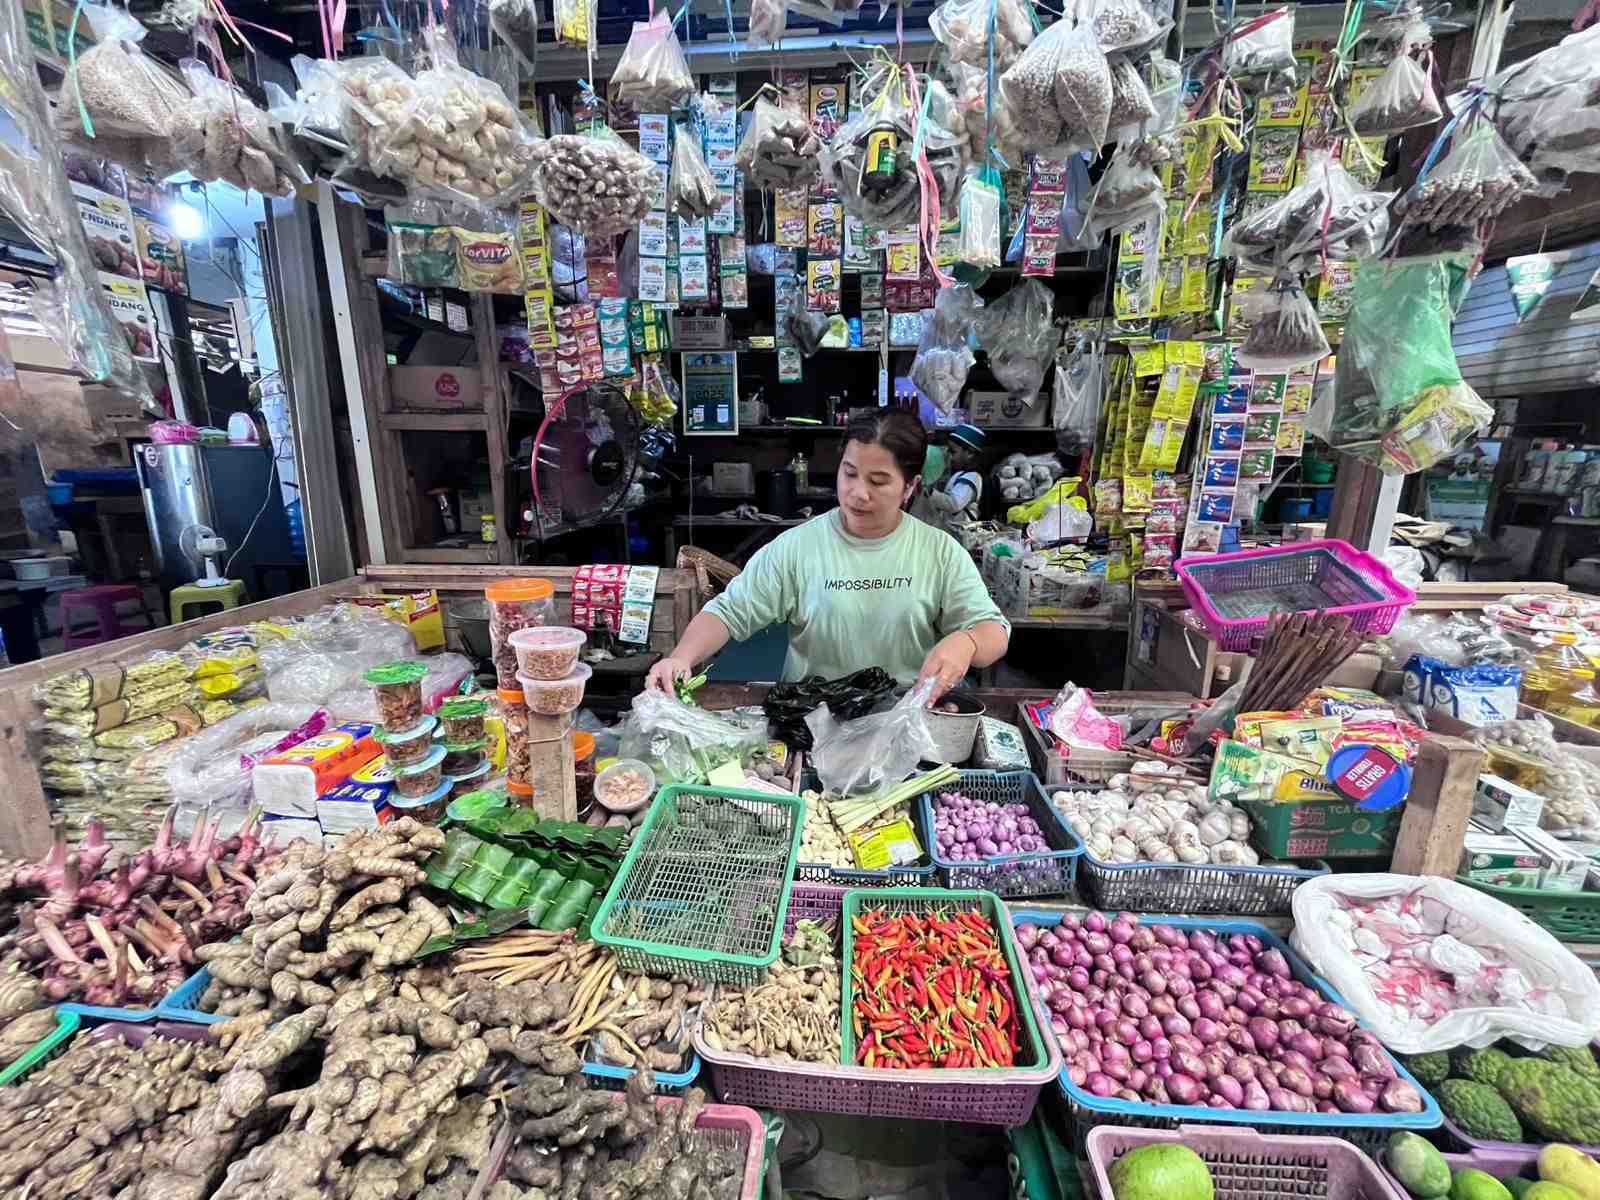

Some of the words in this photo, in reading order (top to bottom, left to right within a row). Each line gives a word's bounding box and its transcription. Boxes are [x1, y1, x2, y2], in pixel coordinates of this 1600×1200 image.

[81, 211, 128, 230] ENDANG
[824, 576, 913, 591] IMPOSSIBILITY
[1355, 764, 1387, 791] GRATIS
